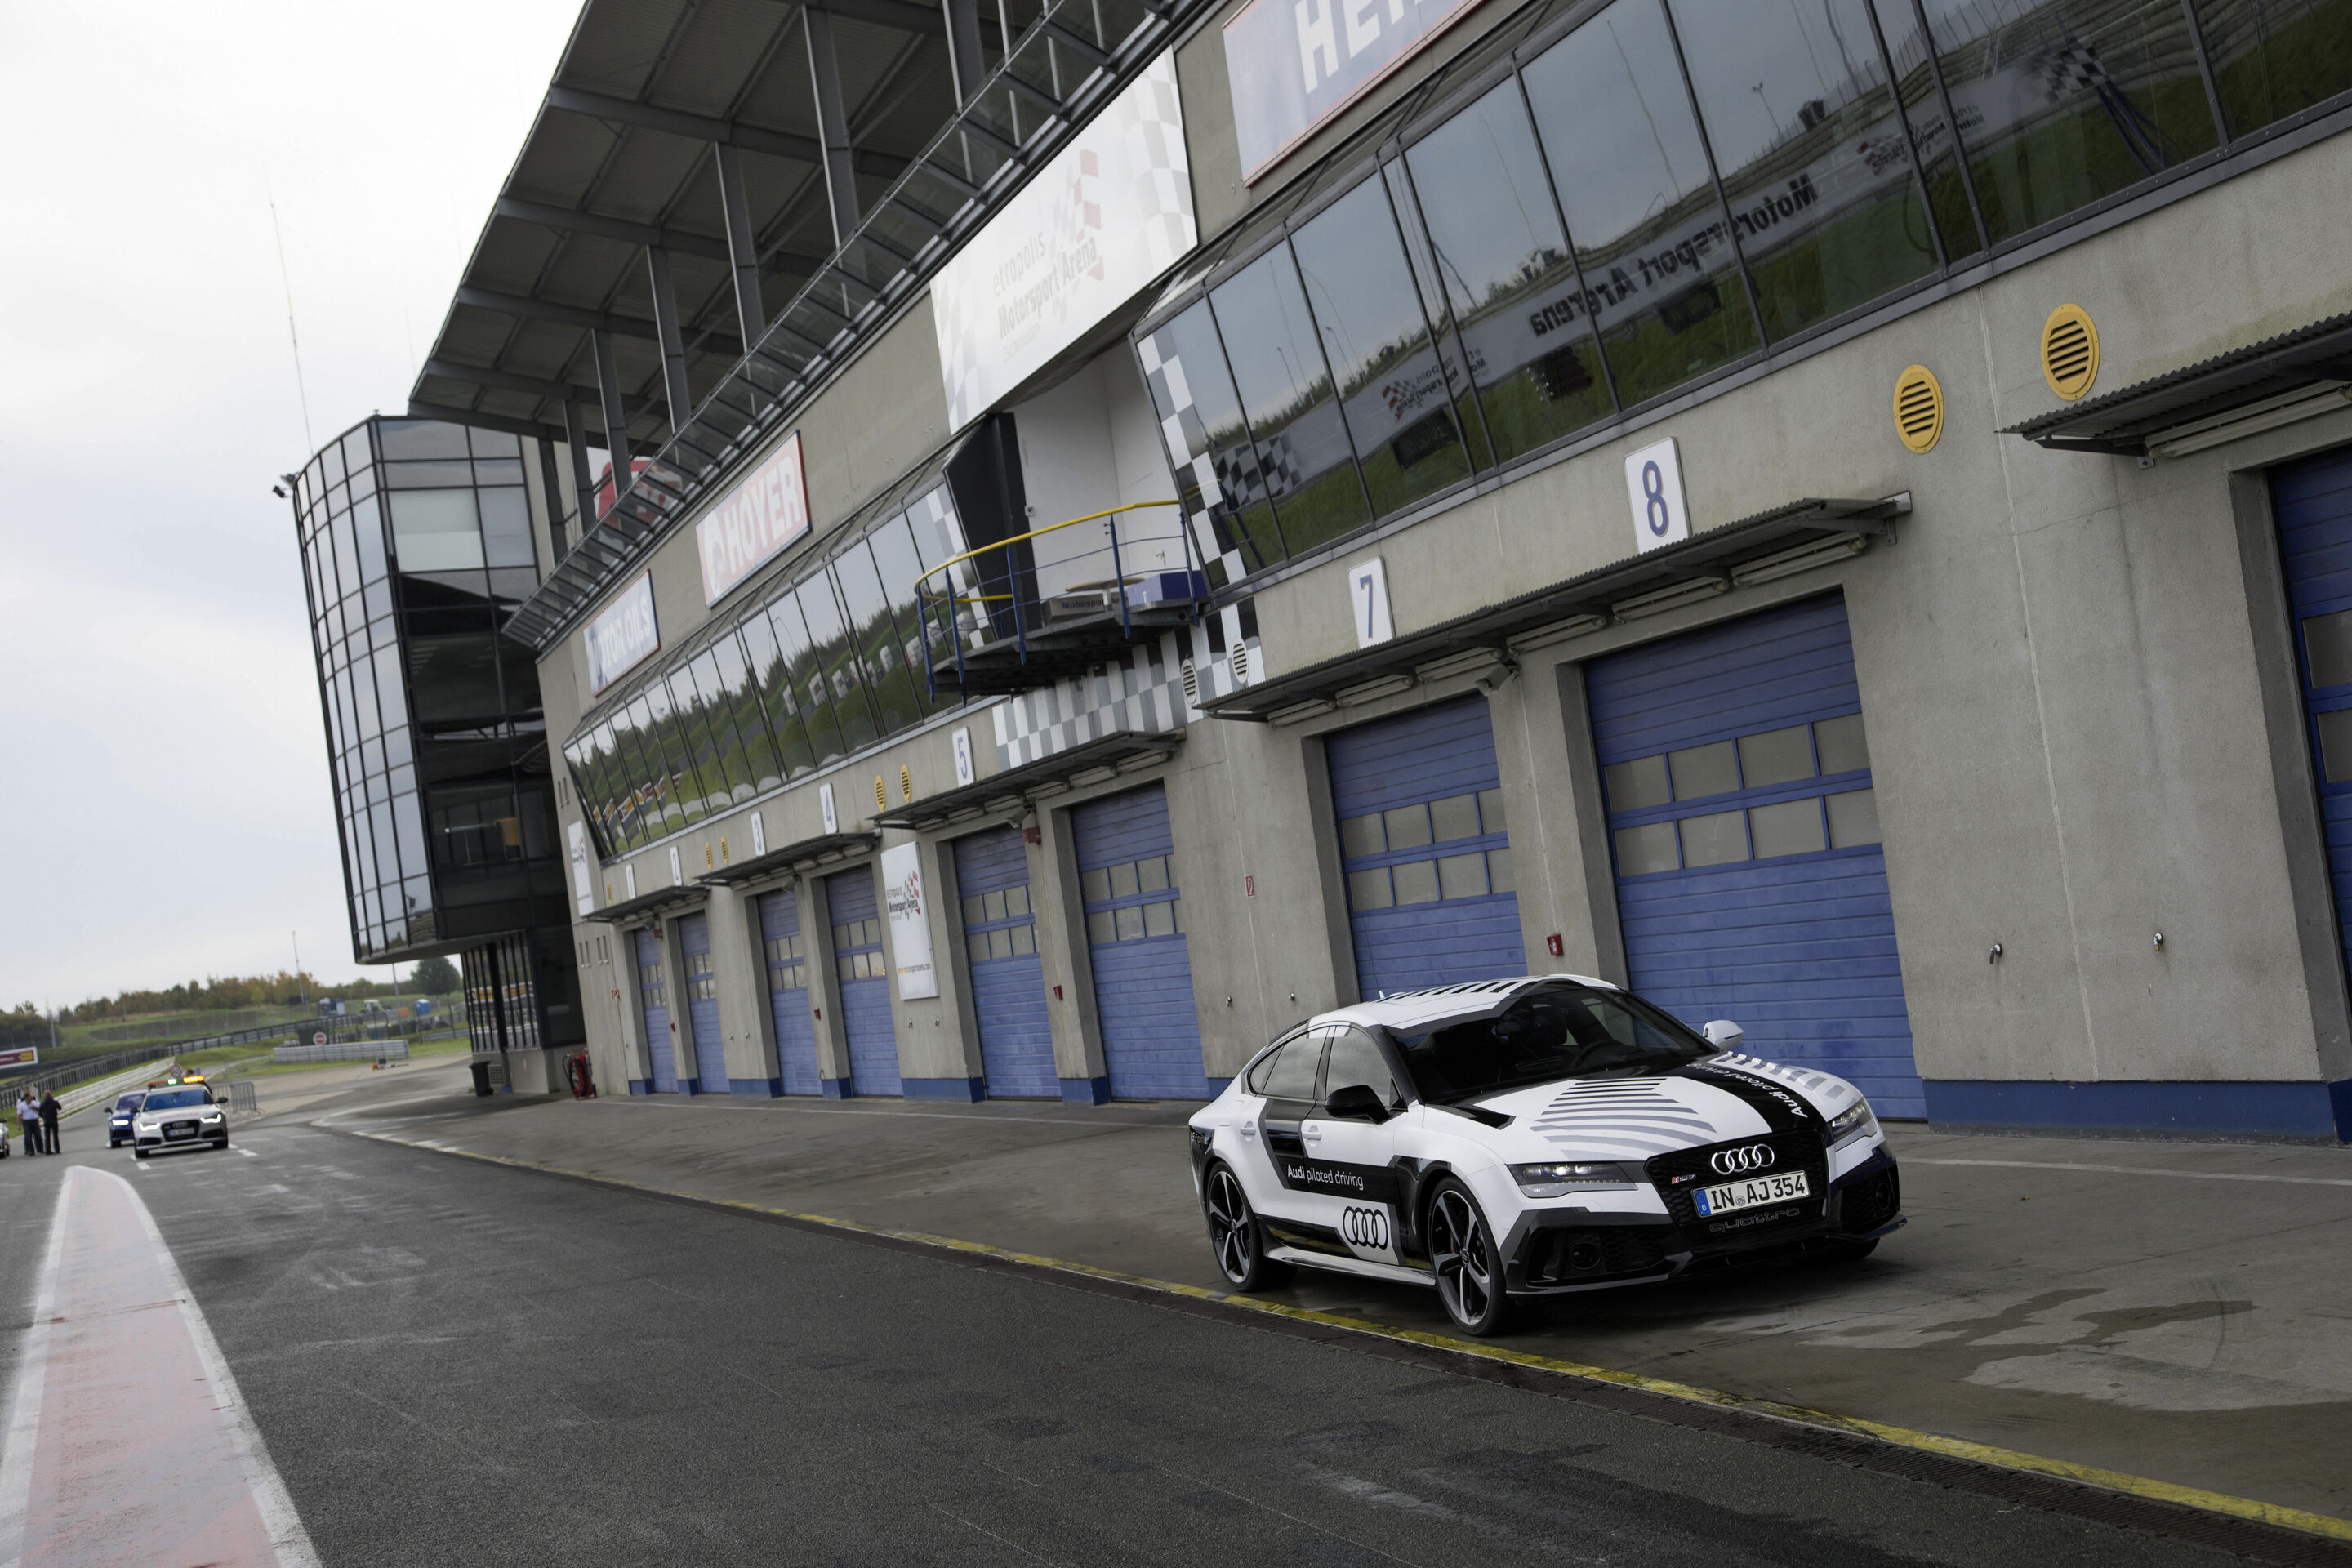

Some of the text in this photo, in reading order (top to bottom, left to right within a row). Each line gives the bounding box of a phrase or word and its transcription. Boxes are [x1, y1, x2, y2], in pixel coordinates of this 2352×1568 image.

[1294, 0, 1424, 95] HE
[992, 231, 1045, 296] etropolis
[998, 235, 1098, 340] Motorsport Arena
[724, 456, 801, 574] HOYER
[1642, 459, 1669, 537] 8
[625, 595, 651, 651] OILS
[1359, 574, 1373, 639] 7
[957, 737, 968, 778] 5
[825, 791, 833, 826] 4
[754, 818, 762, 851] 3
[671, 853, 679, 881] 2
[889, 898, 919, 915] Motorsport Arena
[1725, 1073, 1779, 1090] piloted
[1769, 1091, 1808, 1118] Audi
[1287, 1164, 1364, 1191] Audi piloted driving
[1710, 1187, 1735, 1210] IN
[1746, 1181, 1771, 1204] AJ
[1771, 1174, 1806, 1198] 354
[1709, 1207, 1800, 1233] quattro
